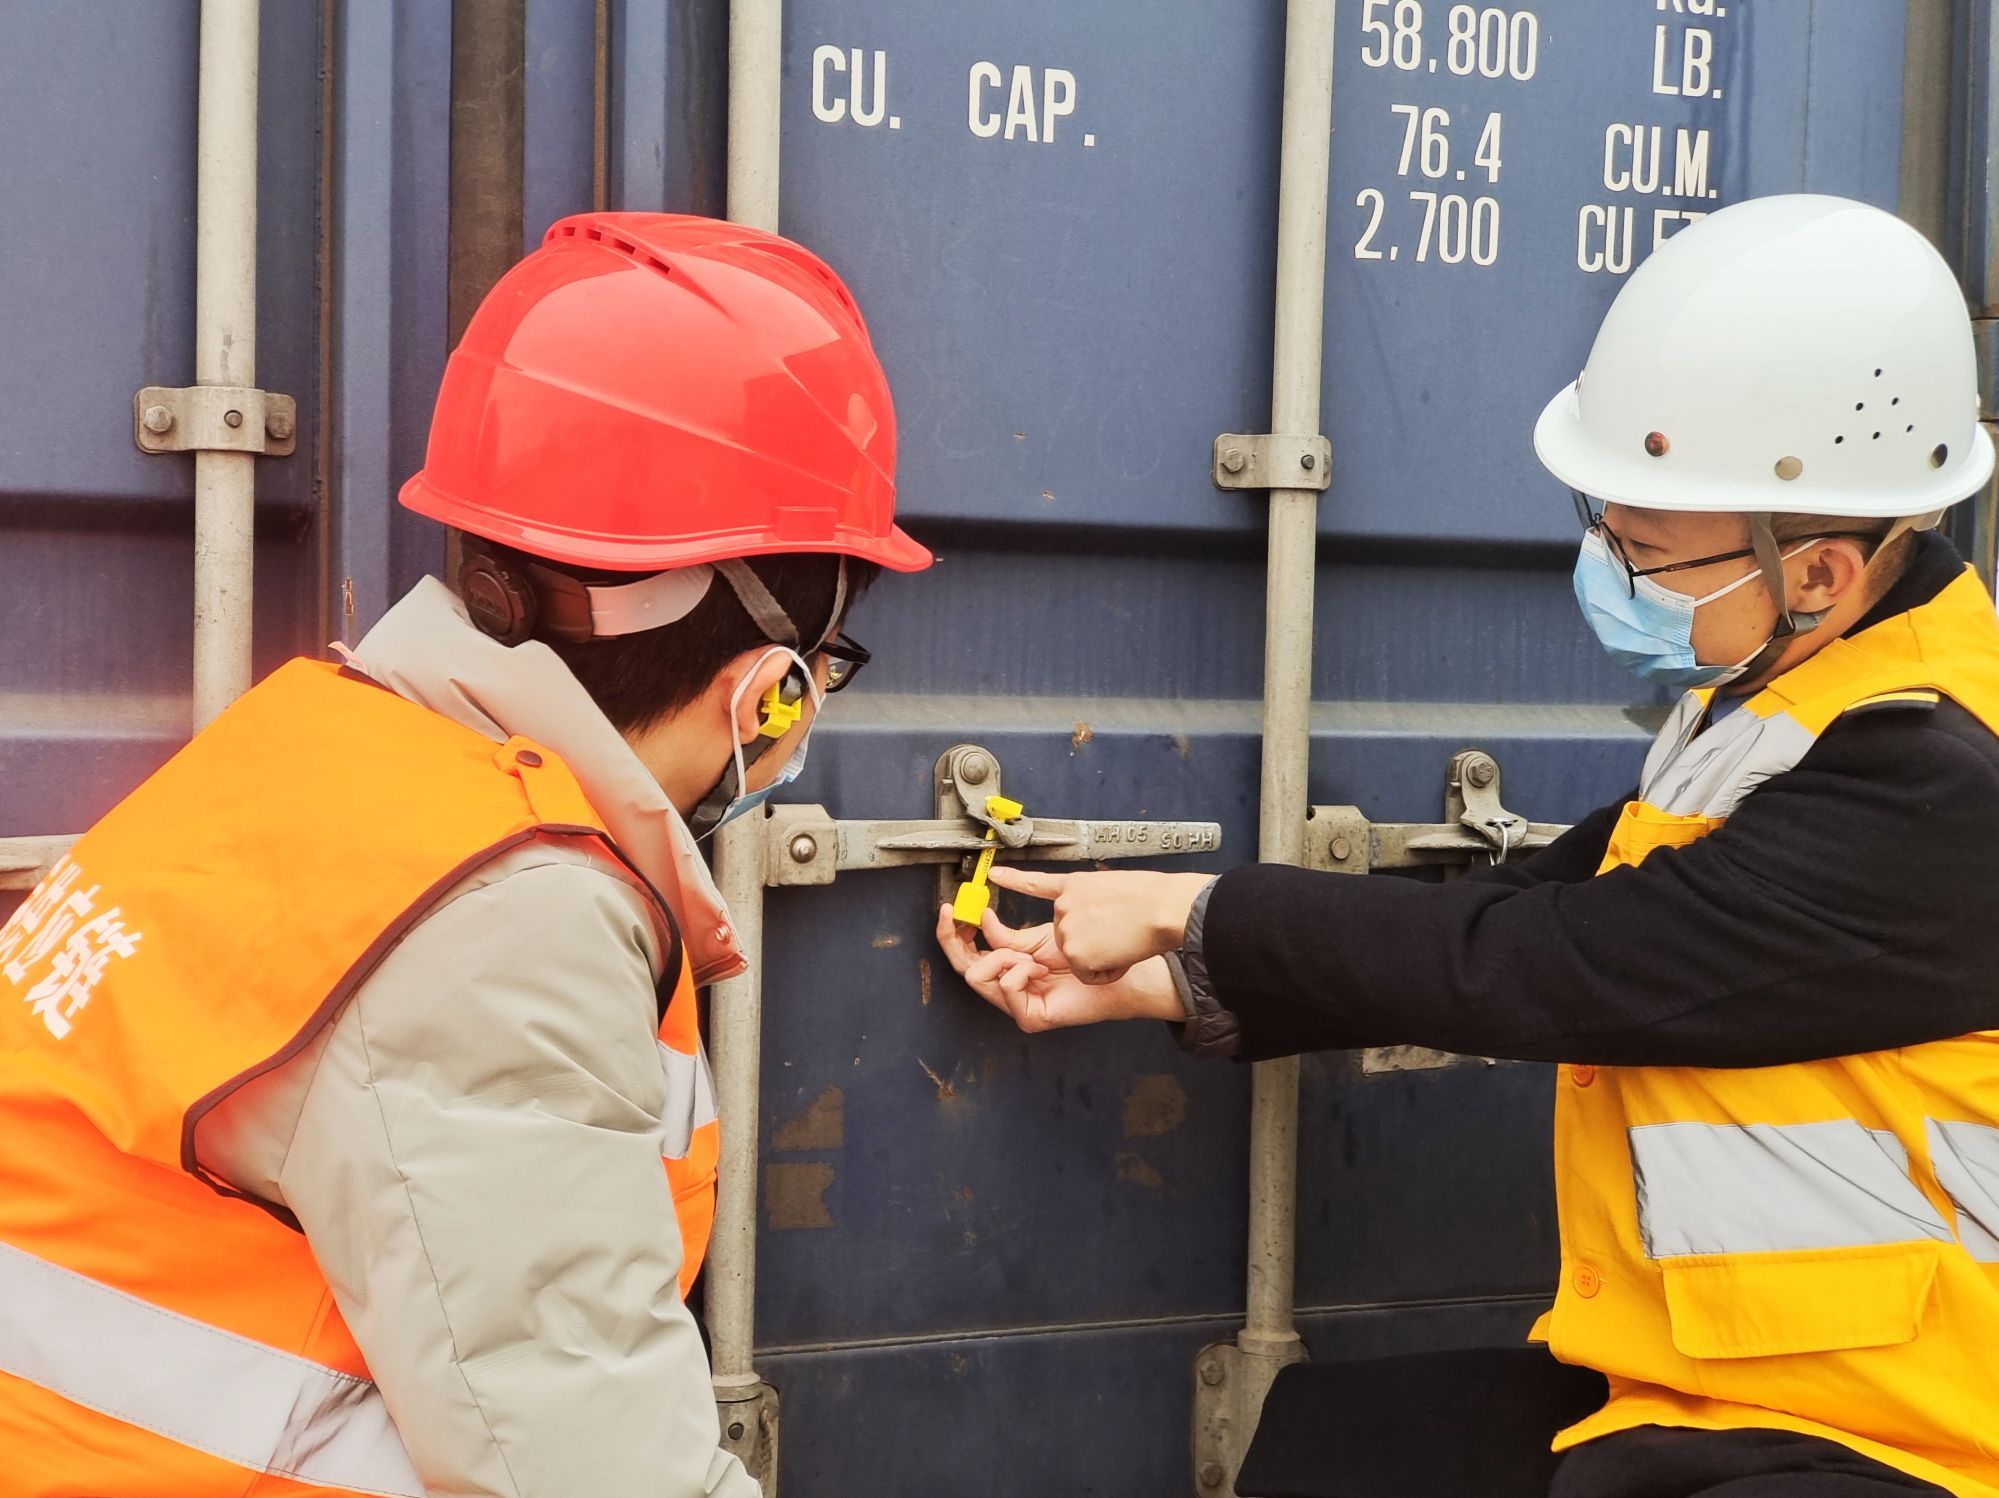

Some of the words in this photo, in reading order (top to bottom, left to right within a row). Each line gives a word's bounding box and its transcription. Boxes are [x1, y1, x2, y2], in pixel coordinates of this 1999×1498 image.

[811, 44, 901, 129] CU.
[967, 61, 1096, 147] CAP.
[1390, 104, 1502, 183] 76.4
[1652, 24, 1723, 99] LB.
